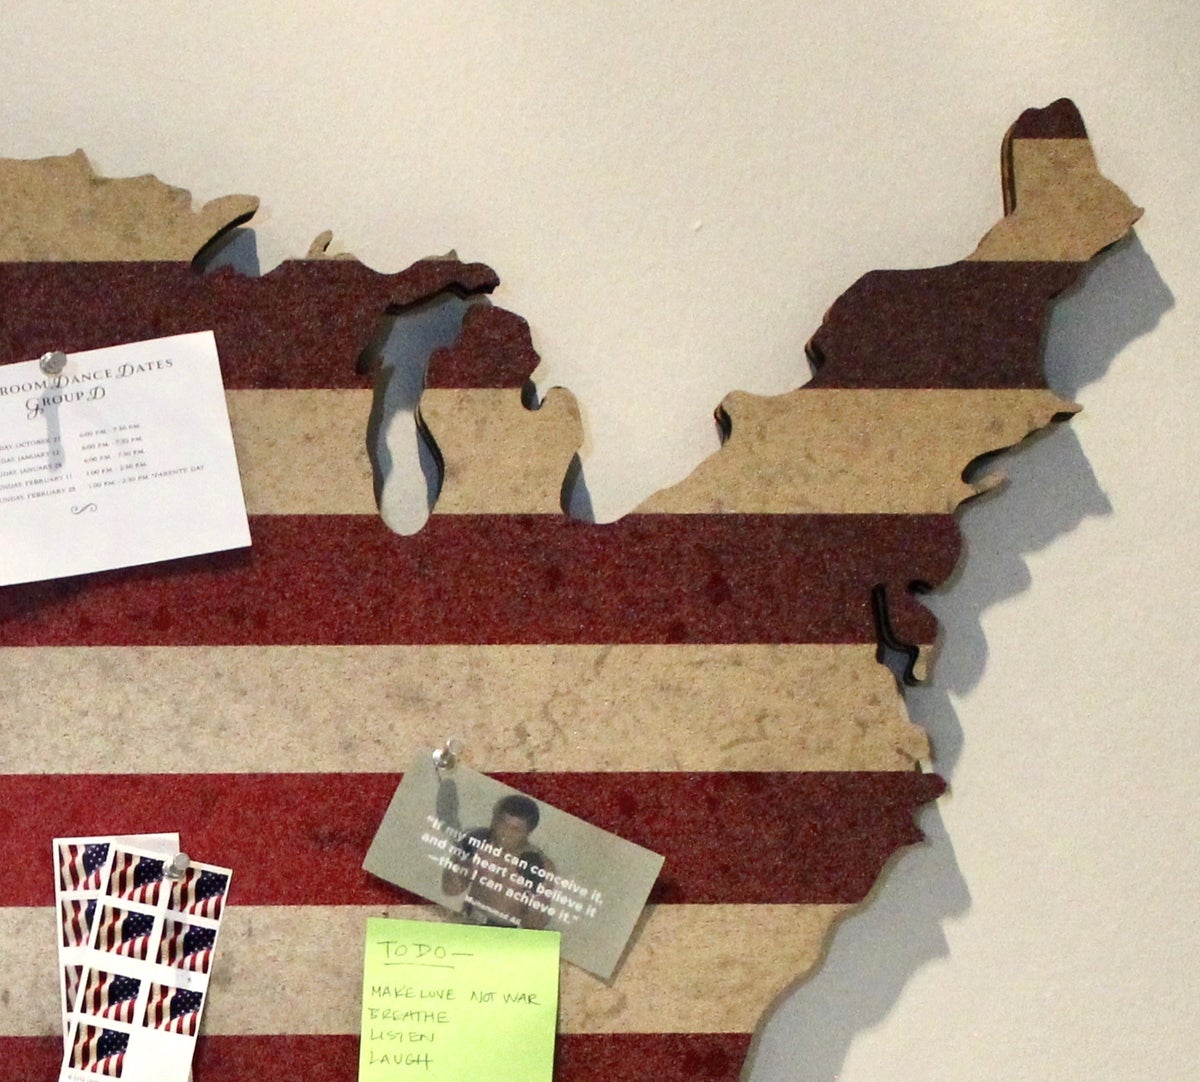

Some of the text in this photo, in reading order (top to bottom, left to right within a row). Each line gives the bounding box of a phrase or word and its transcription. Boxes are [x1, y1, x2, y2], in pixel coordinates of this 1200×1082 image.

[50, 368, 113, 390] DANCE
[115, 358, 174, 379] DATES
[25, 385, 106, 420] GROUP D
[15, 438, 50, 448] OCTOBER
[17, 451, 49, 461] JANUARY
[19, 463, 52, 474] JANUARY
[24, 475, 62, 486] FEBRUARY
[26, 488, 65, 498] FEBRUARY
[444, 825, 465, 842] my
[467, 834, 502, 857] mind
[504, 852, 529, 869] can
[530, 863, 589, 899] conceive
[421, 832, 597, 917] and my heart can believe it
[480, 876, 503, 892] can
[505, 886, 557, 917] achieve
[377, 941, 407, 958] TO
[372, 985, 416, 998] MAKE
[471, 991, 496, 1003] NOT
[504, 993, 541, 1005] WAR
[368, 1008, 449, 1023] BREATHE
[370, 1029, 434, 1043] LISTEN
[369, 1051, 433, 1070] LAUGH
